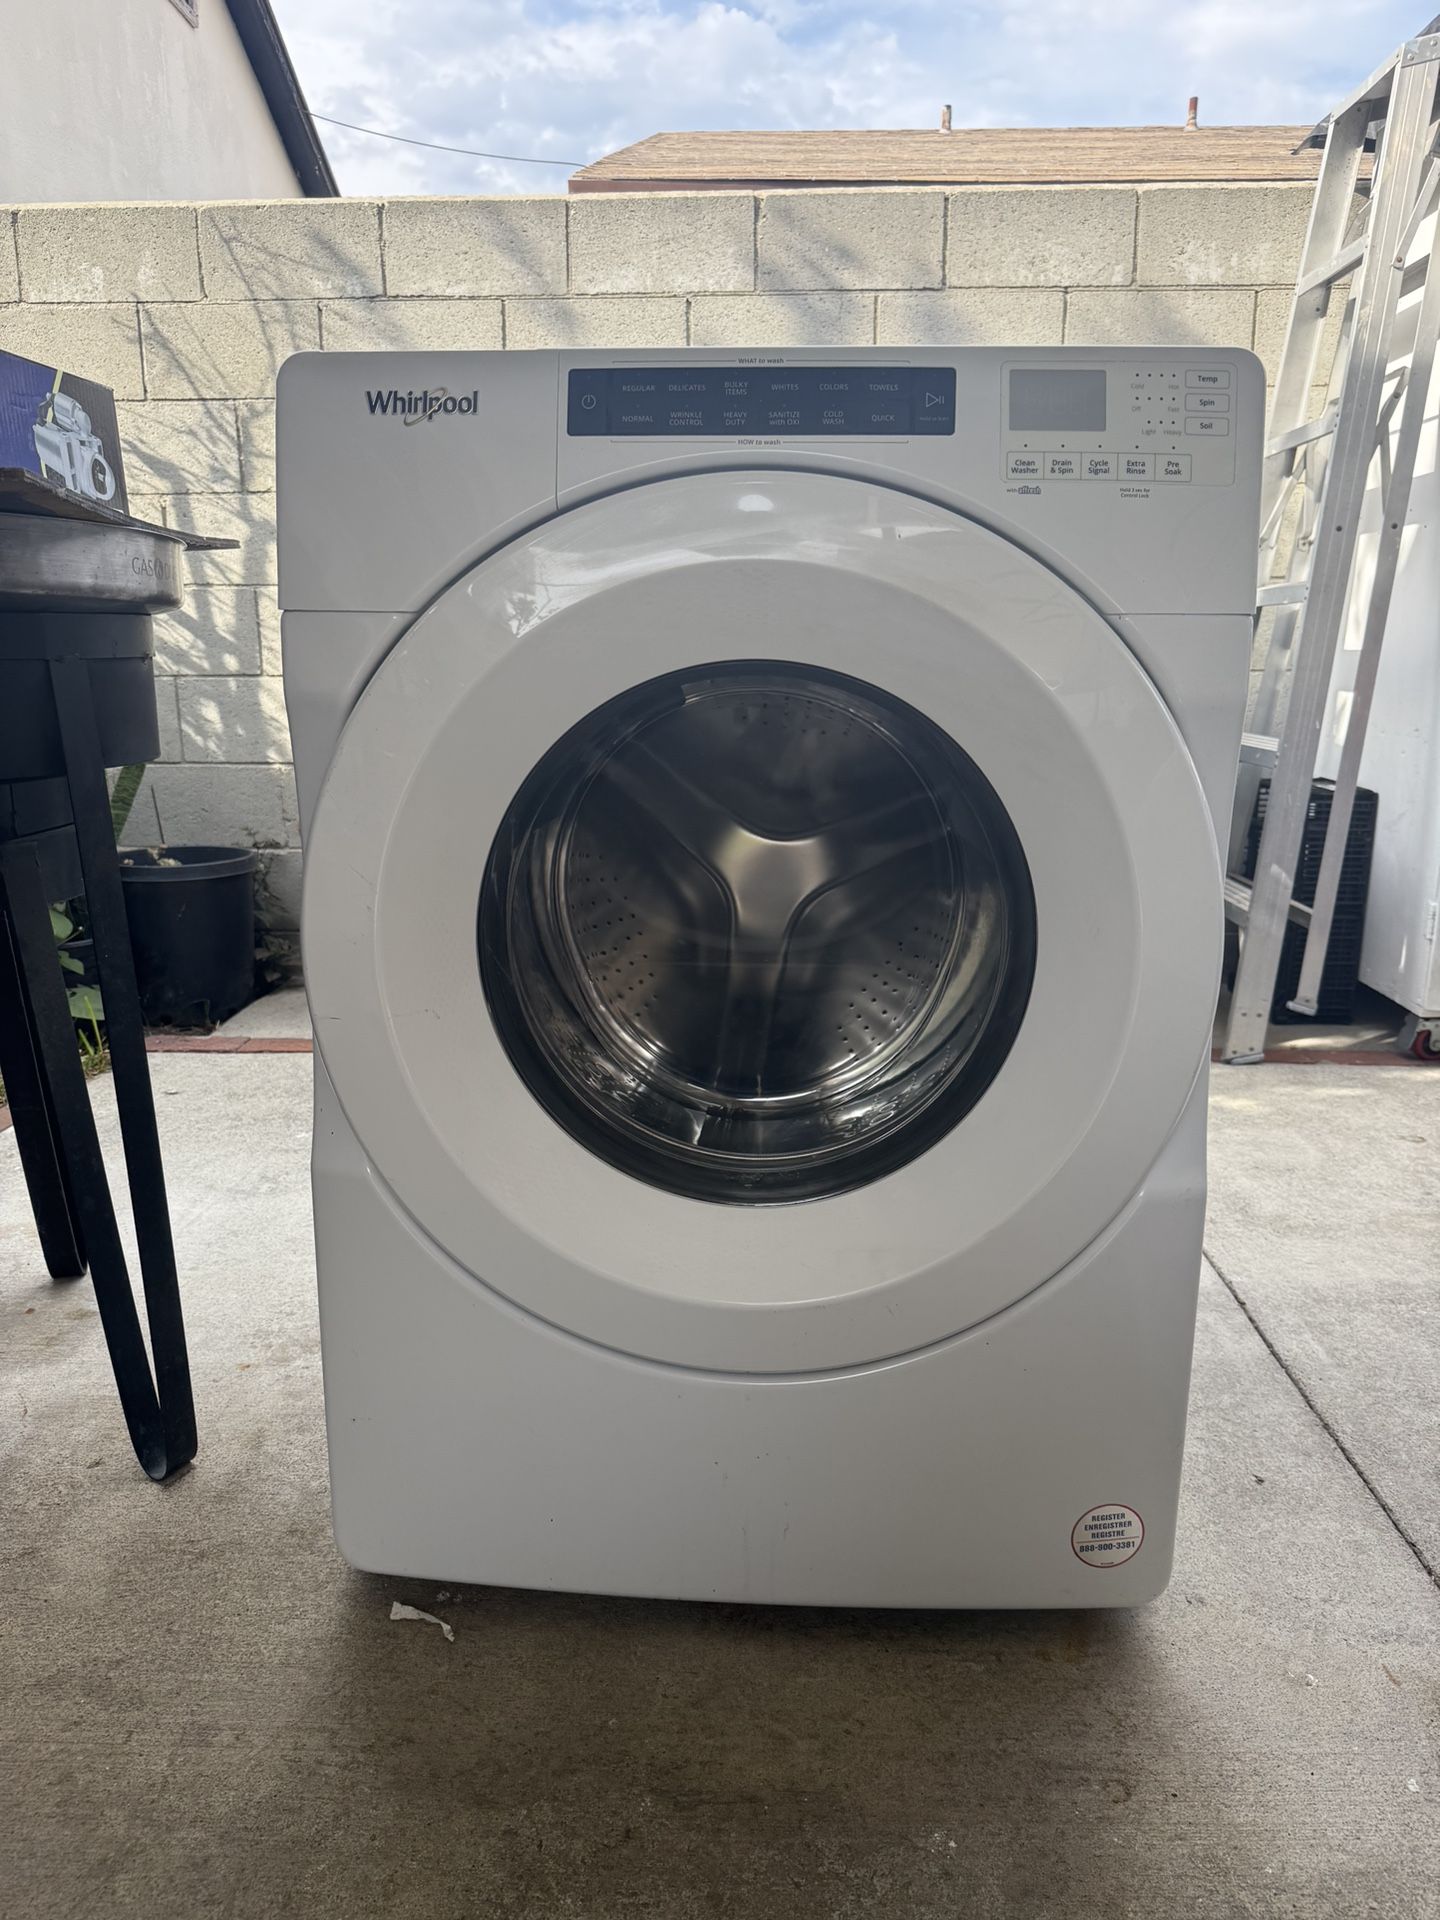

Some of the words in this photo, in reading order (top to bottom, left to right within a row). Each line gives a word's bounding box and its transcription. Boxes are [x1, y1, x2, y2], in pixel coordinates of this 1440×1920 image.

[1198, 375, 1218, 383] Temp
[771, 383, 799, 391] WHITES
[725, 388, 747, 396] ITEMS
[366, 390, 479, 422] Whirlpool
[1199, 399, 1215, 407] Spin
[622, 415, 654, 423] NORMAL
[669, 418, 704, 426] CONTROL
[725, 418, 746, 426] DUTY
[1015, 459, 1036, 467] Clean
[1052, 459, 1073, 467] Drain
[1089, 459, 1109, 468] Cycle
[1126, 460, 1146, 468] Extra
[1167, 460, 1180, 468] Pre
[1011, 466, 1039, 474] Washer
[1057, 467, 1074, 475] Spin
[1088, 467, 1110, 476] Signal
[1164, 468, 1182, 476] Soak
[1092, 1512, 1126, 1522] REGISTER
[1084, 1520, 1133, 1531] ENREGISTRER
[1091, 1529, 1125, 1539] REGISTRE
